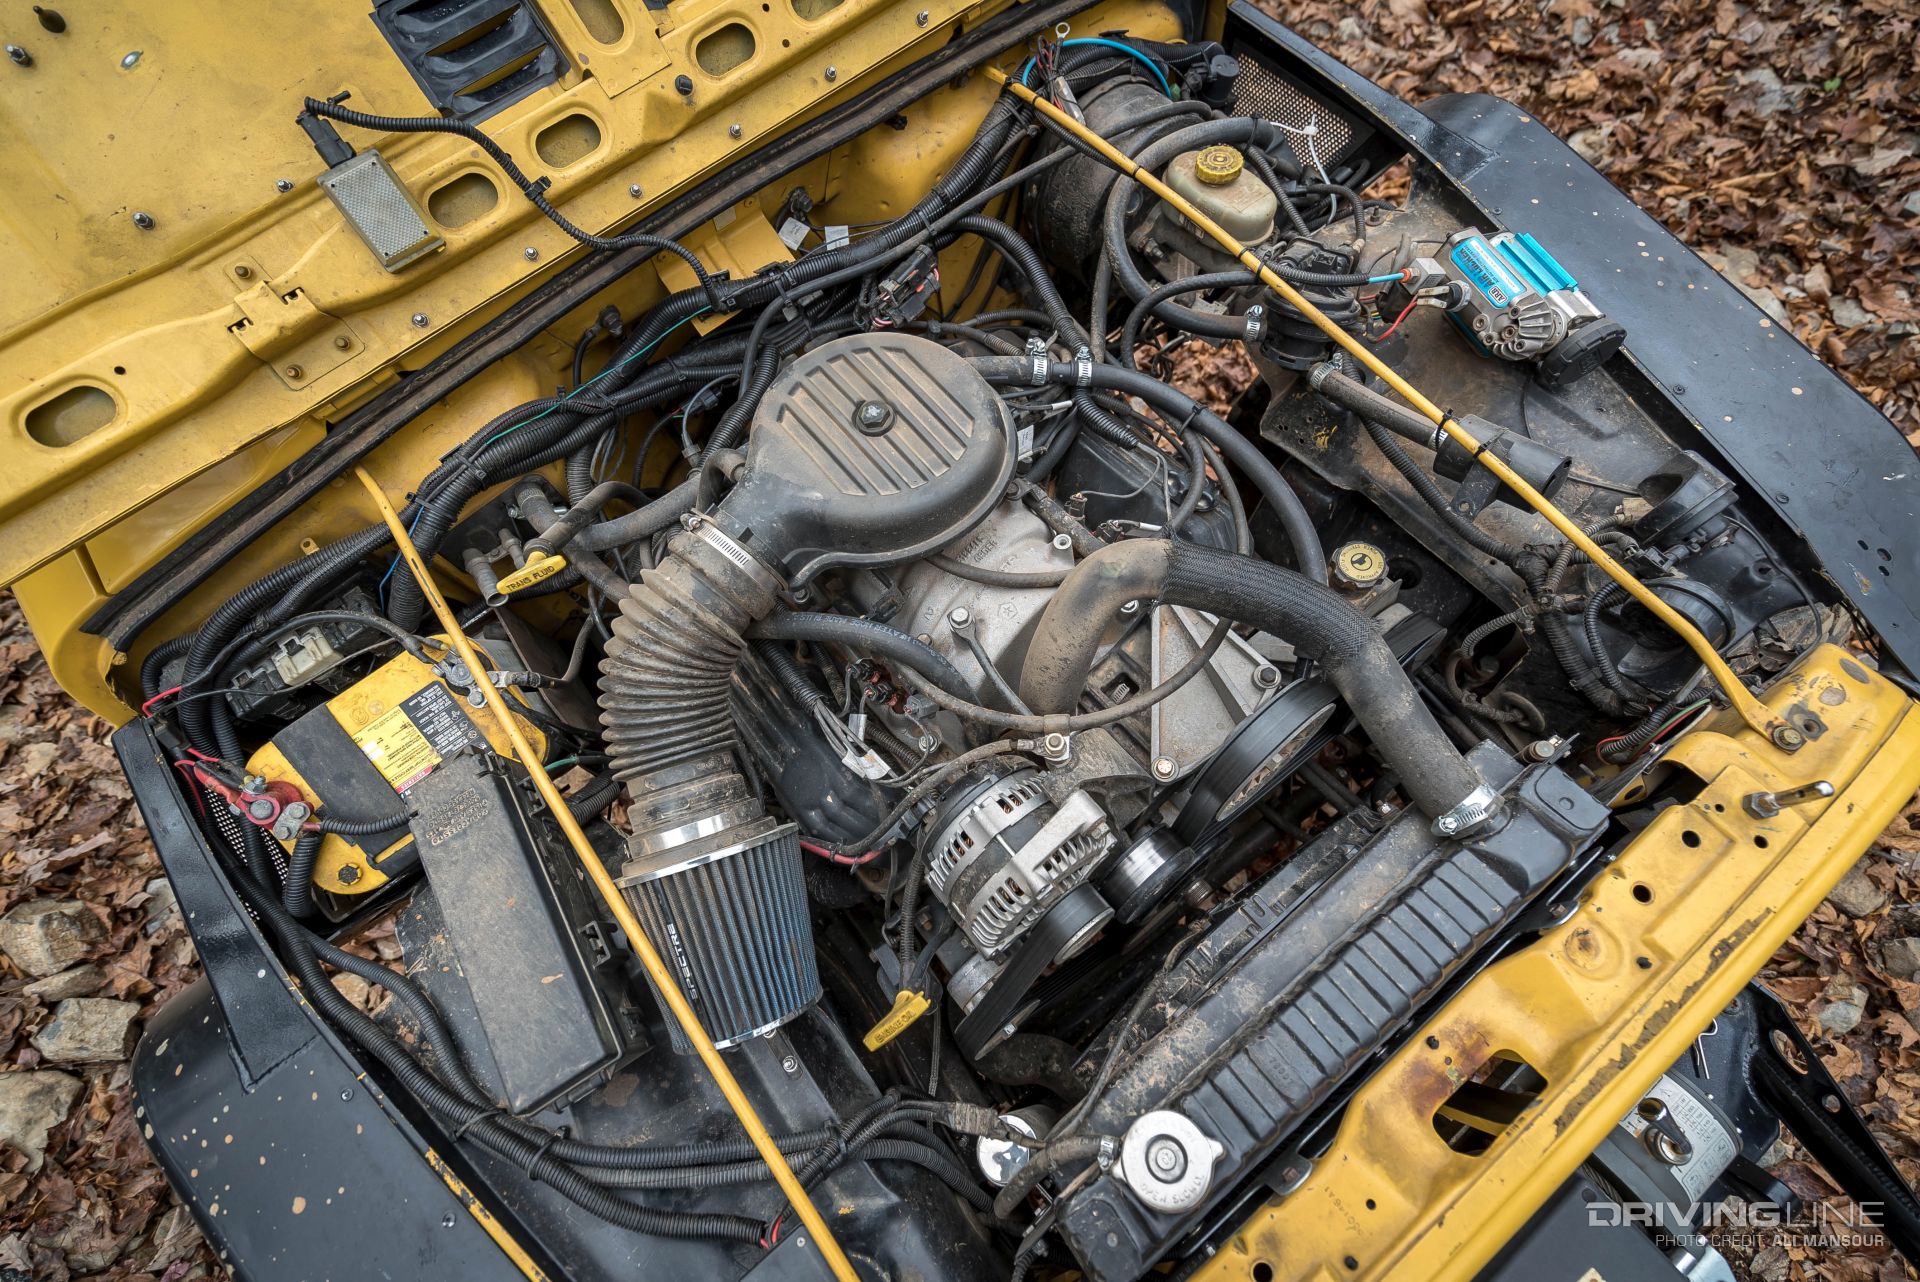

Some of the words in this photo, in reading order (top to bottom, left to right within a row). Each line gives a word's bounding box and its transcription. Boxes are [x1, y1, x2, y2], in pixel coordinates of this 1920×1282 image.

[1490, 286, 1505, 302] ARB
[506, 577, 531, 591] TRANS
[533, 565, 555, 579] FLUID
[666, 922, 698, 1000] SPECTRE
